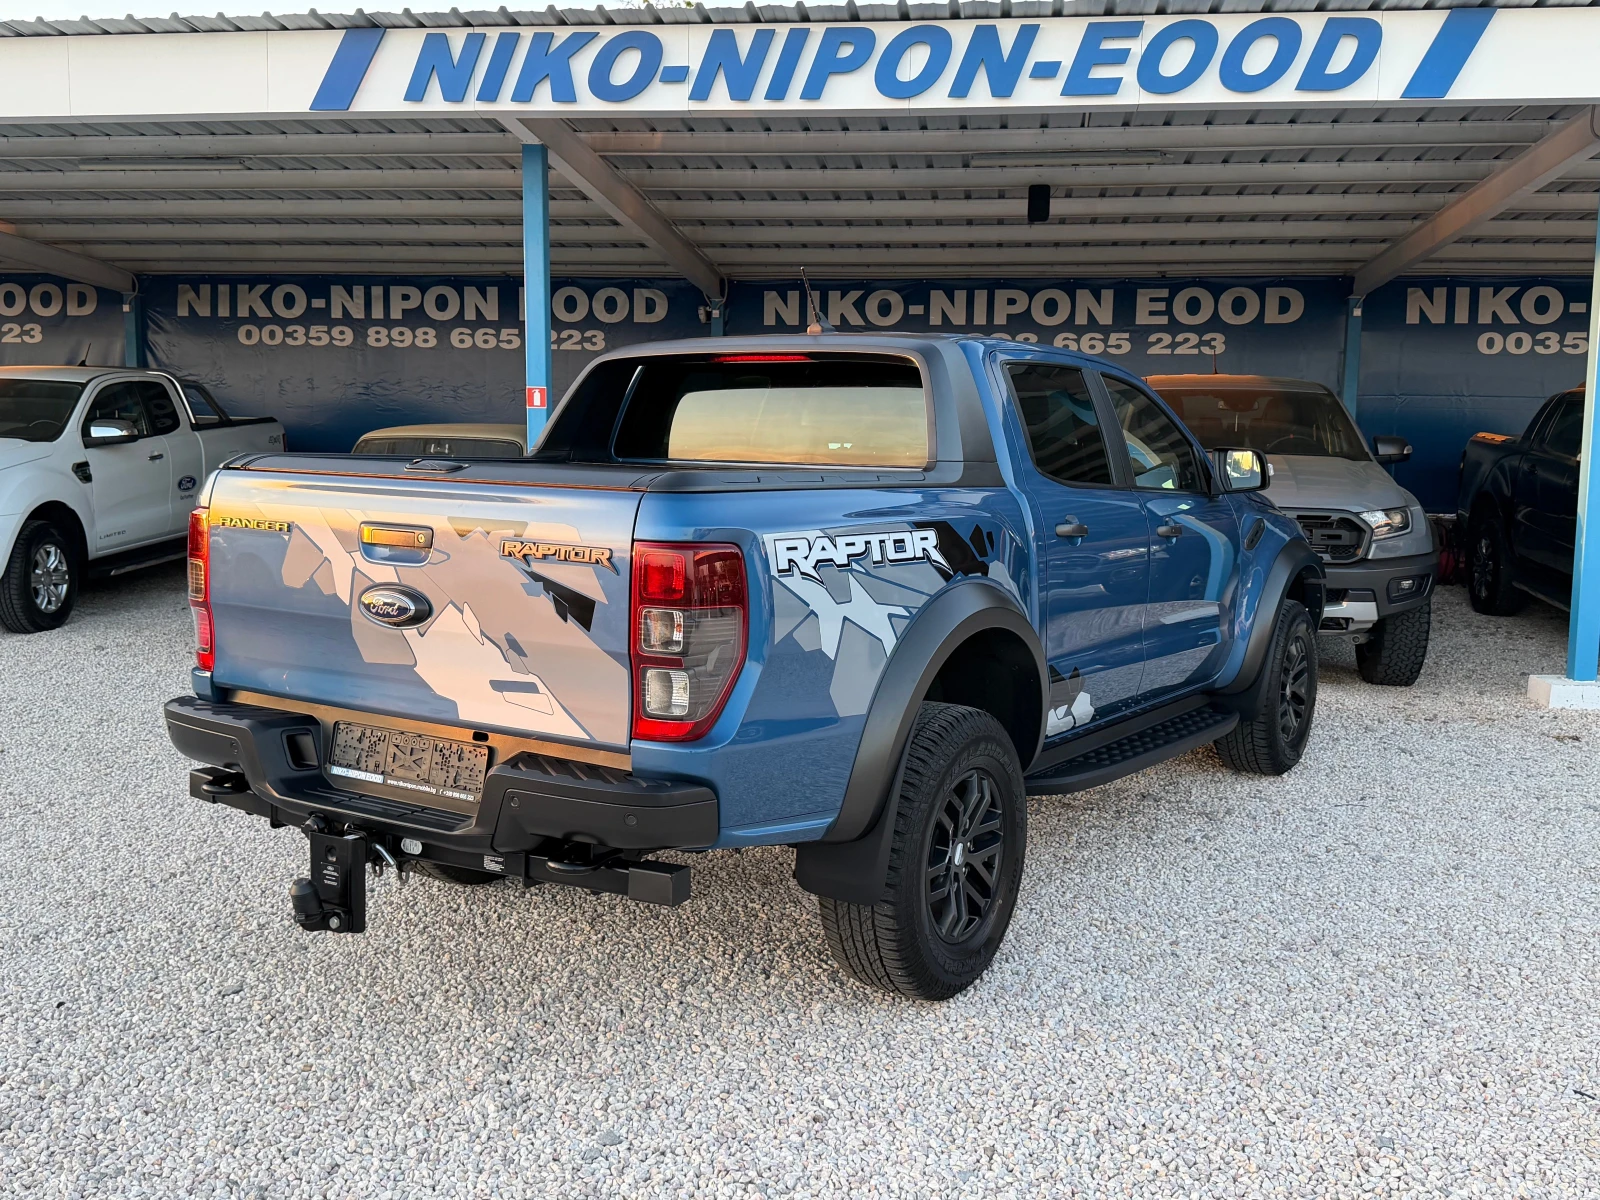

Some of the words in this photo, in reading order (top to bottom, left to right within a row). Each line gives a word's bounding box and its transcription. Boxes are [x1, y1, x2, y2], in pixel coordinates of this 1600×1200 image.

[402, 16, 1384, 103] NIKO-NIPON-EOOD
[0, 282, 98, 317] OOD
[177, 283, 499, 321] NIKO-NIPON
[519, 286, 669, 323] OOD
[763, 289, 1114, 327] NIKO-NIPON
[1135, 286, 1305, 326] EOOD
[1405, 286, 1587, 325] NIKO-
[237, 324, 354, 347] 00359
[366, 326, 437, 348] 898
[450, 327, 521, 350] 665
[551, 329, 606, 351] 23
[1053, 332, 1131, 355] 665
[1147, 332, 1226, 355] 223
[1477, 332, 1589, 355] 0035
[220, 517, 291, 532] RANGER
[500, 538, 620, 576] RAPTOR
[774, 528, 954, 588] RAPTOR
[369, 596, 399, 616] Ford
